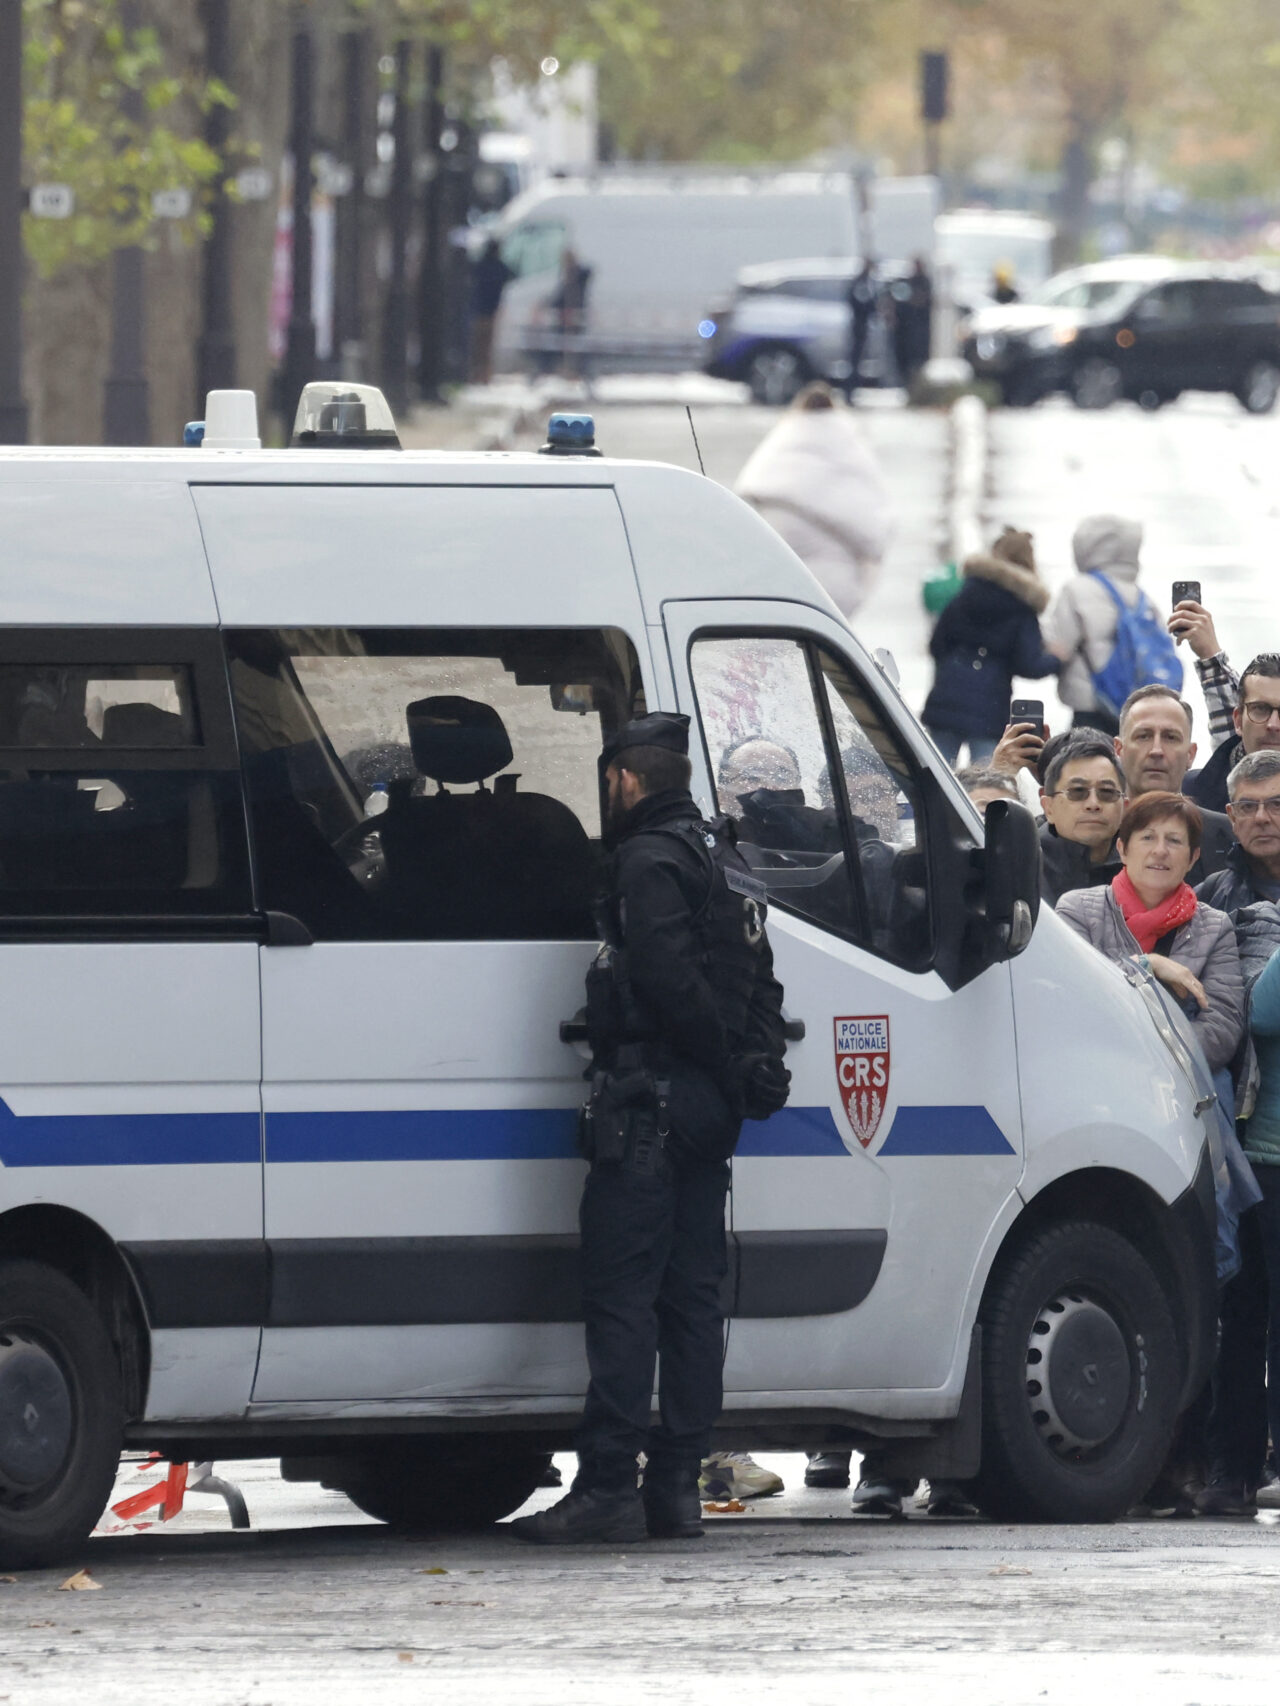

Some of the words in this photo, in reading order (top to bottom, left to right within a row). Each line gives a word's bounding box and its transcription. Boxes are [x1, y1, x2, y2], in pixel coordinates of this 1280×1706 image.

[842, 1022, 882, 1036] POLICE
[838, 1037, 887, 1051] NATIONALE
[839, 1056, 887, 1088] CRS
